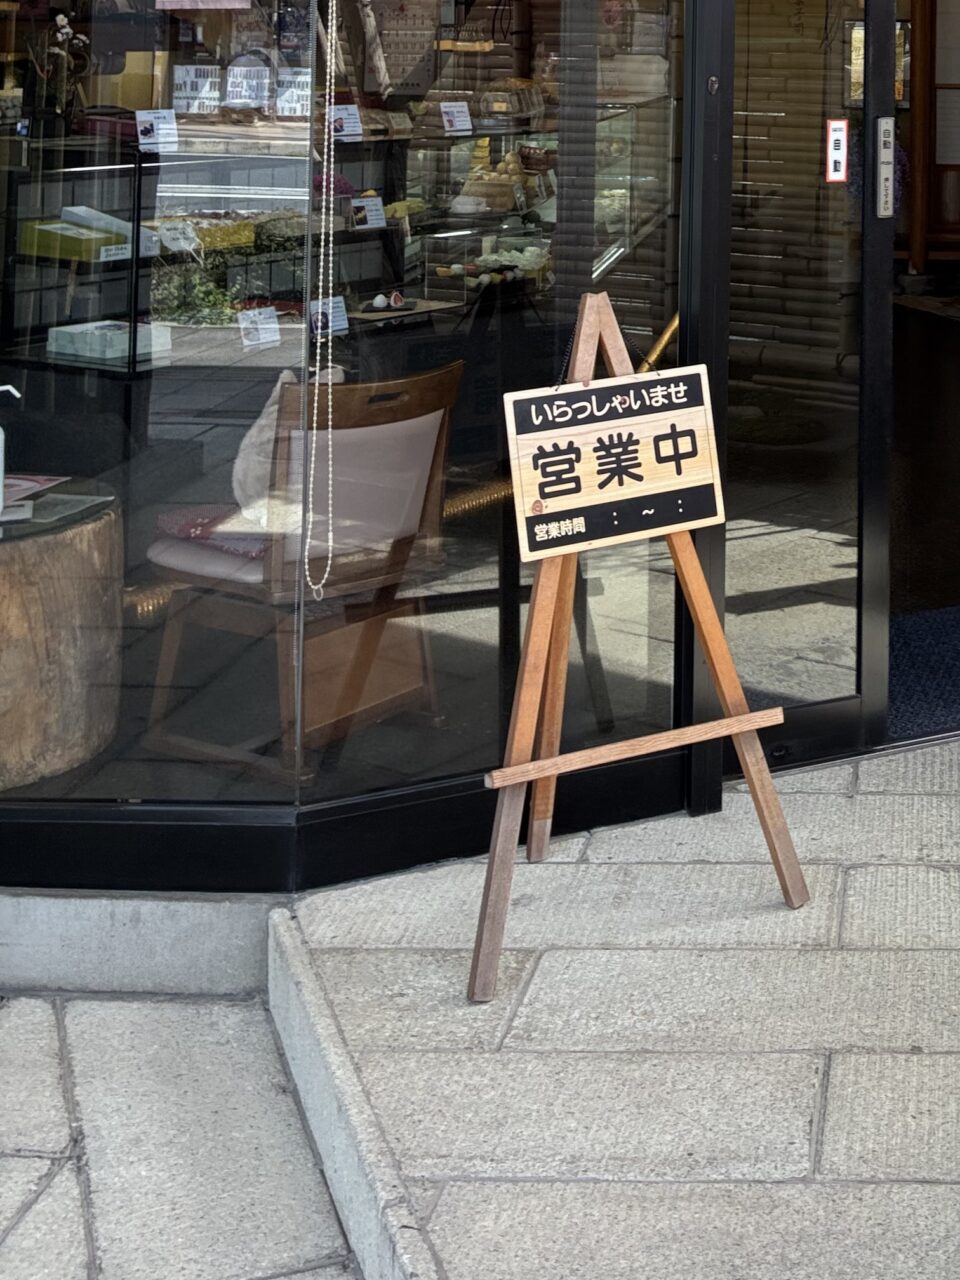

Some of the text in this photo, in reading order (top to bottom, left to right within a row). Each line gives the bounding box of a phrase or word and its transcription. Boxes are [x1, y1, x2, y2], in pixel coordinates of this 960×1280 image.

[530, 381, 688, 426] いらっしゃいませ
[531, 422, 699, 501] 営業中
[534, 516, 586, 542] 営業時間
